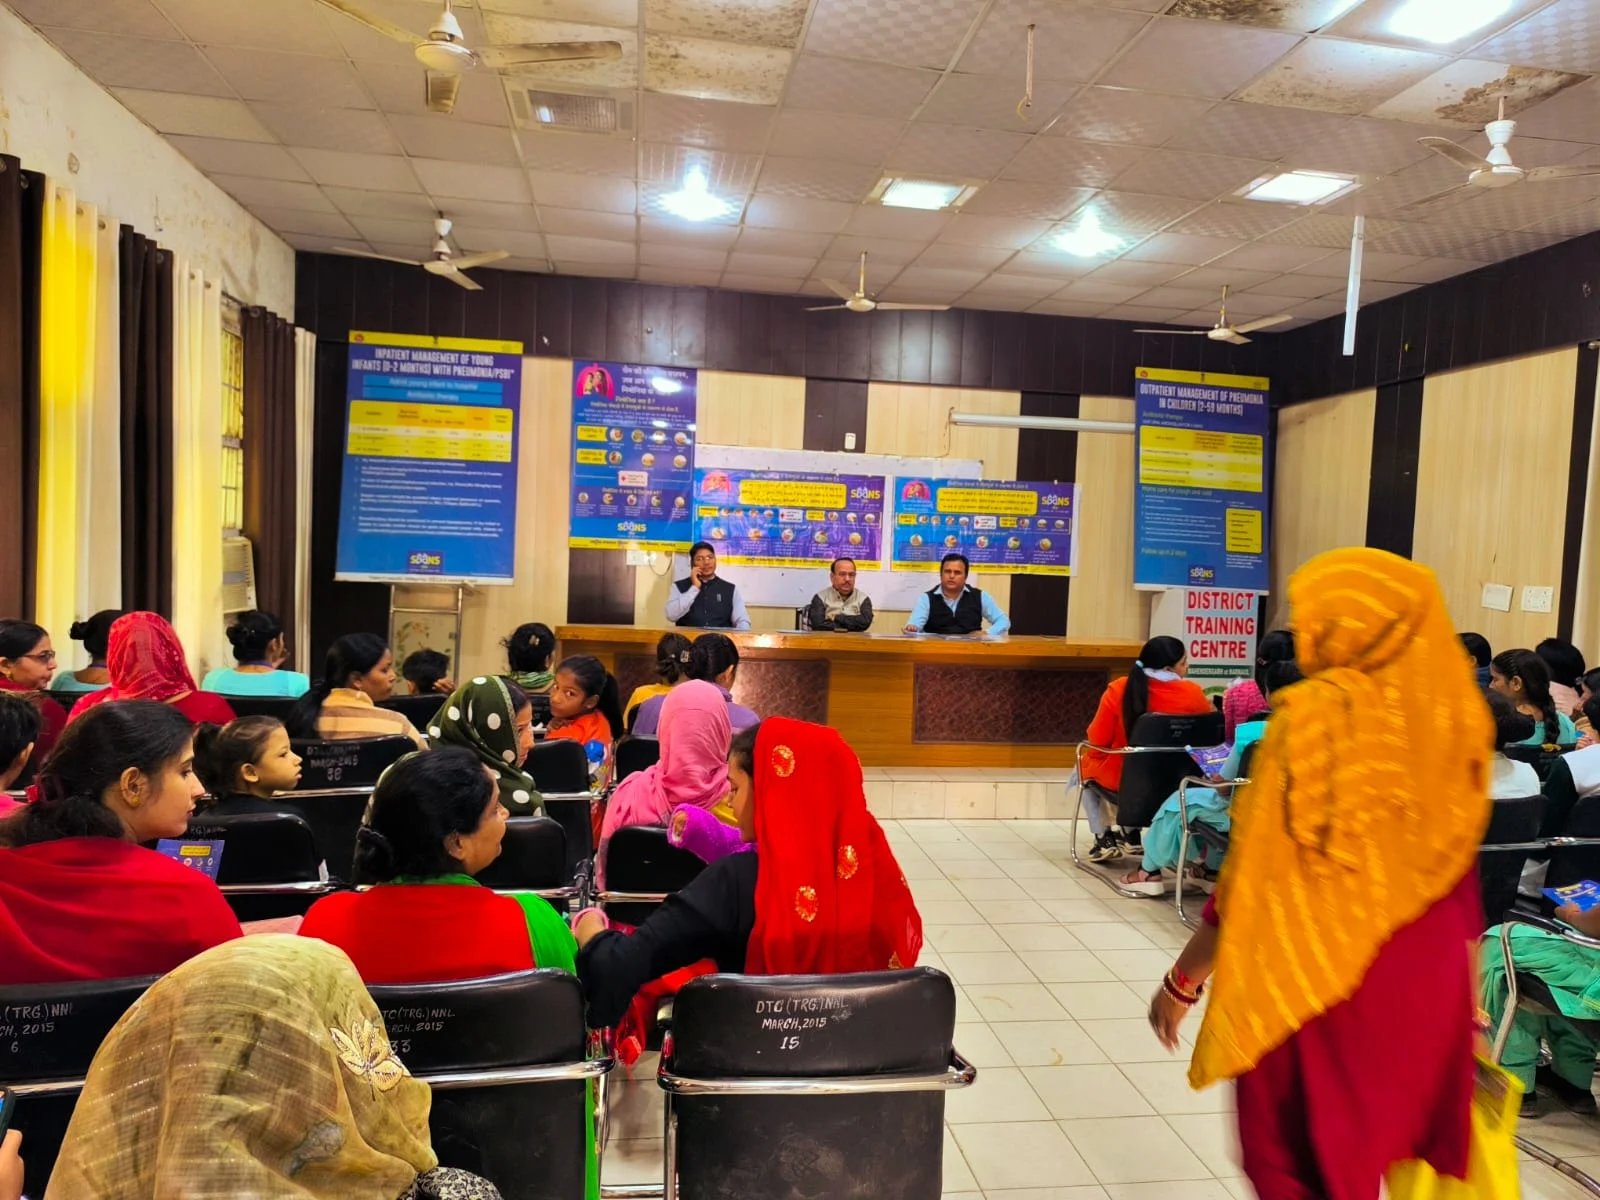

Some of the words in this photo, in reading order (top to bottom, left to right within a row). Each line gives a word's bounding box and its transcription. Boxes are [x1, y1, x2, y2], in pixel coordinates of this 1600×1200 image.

[375, 348, 410, 360] INPATIENT
[411, 351, 459, 364] MANAGEMENT
[460, 354, 470, 364] OF
[471, 354, 494, 366] YOUNG
[352, 358, 381, 371] INFANTS
[432, 364, 452, 375] WITH
[1140, 383, 1176, 397] OUTPATIENT
[1177, 387, 1219, 402] MANAGEMENT
[1220, 391, 1229, 402] OF
[1229, 392, 1264, 404] PNEUMONIA
[1159, 397, 1166, 408] IN
[1167, 398, 1196, 411] CHILDREN
[1188, 591, 1254, 610] DISTRICT
[1186, 616, 1254, 636] TRAINING
[1190, 640, 1247, 659] CENTRE
[22, 1022, 55, 1035] 2015
[11, 1041, 19, 1053] 6
[780, 1036, 800, 1049] 15
